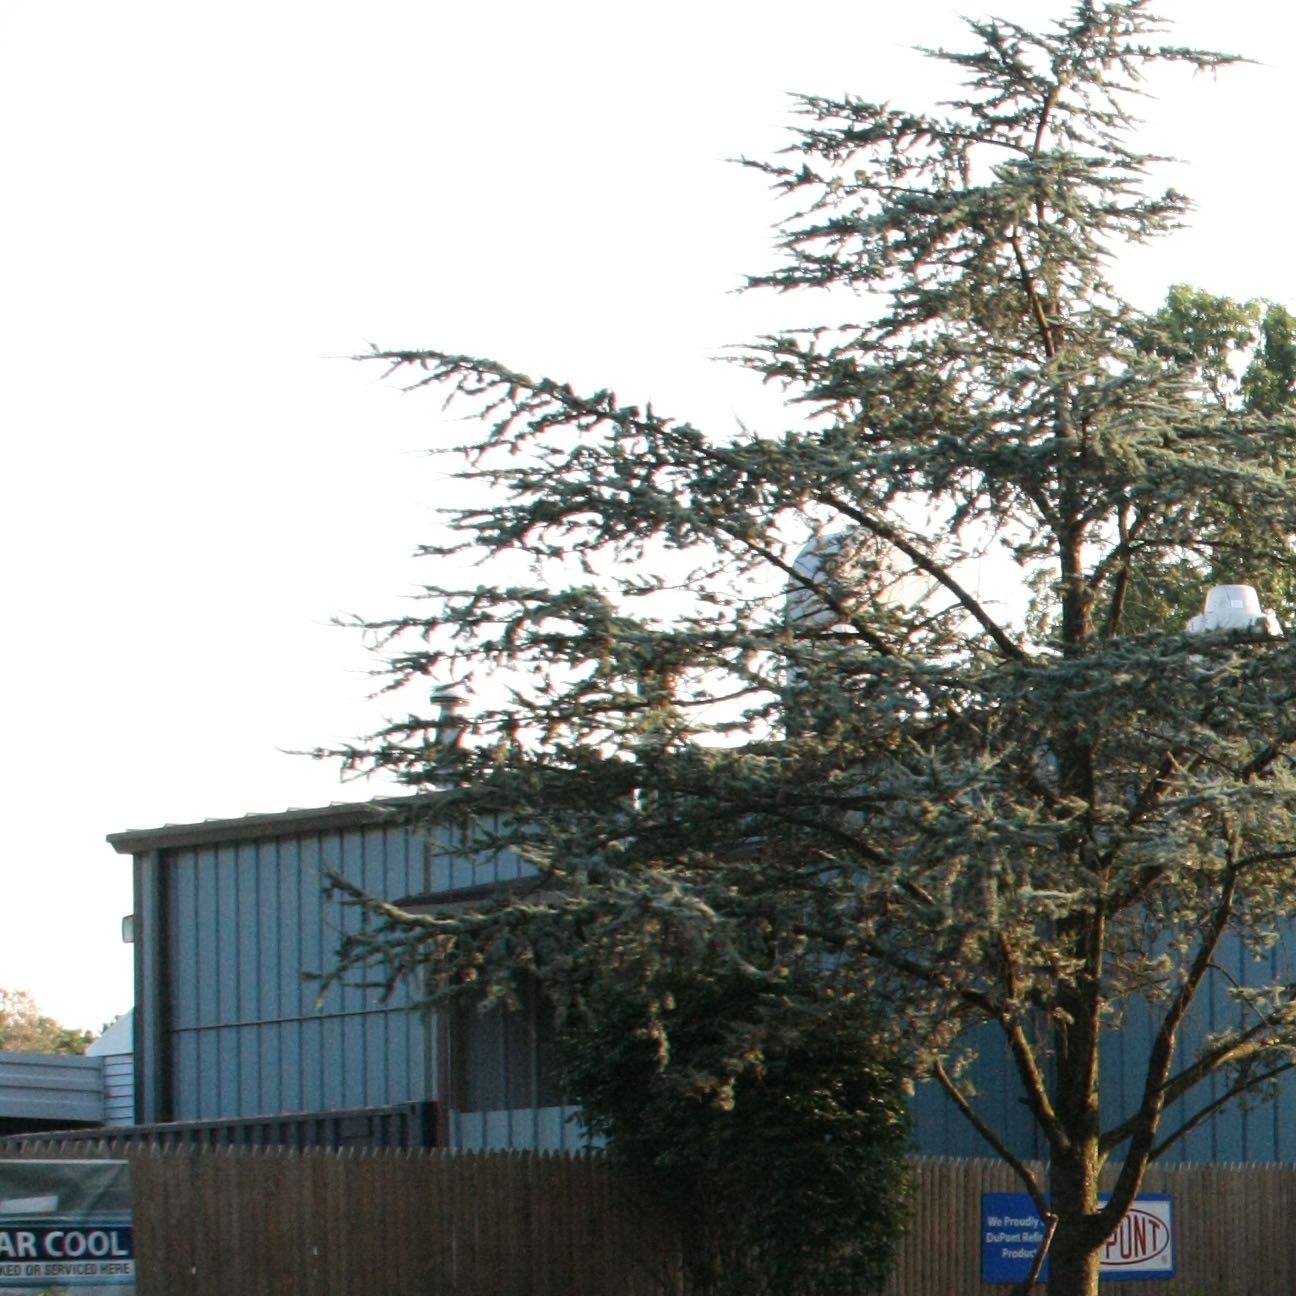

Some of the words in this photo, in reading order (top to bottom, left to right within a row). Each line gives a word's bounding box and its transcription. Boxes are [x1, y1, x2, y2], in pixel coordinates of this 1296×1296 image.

[987, 1215, 1002, 1227] We
[1004, 1215, 1039, 1229] Proudly
[44, 1230, 129, 1258] COOL
[25, 1264, 41, 1277] OR
[44, 1263, 98, 1276] SERVICED
[100, 1262, 131, 1275] HERE
